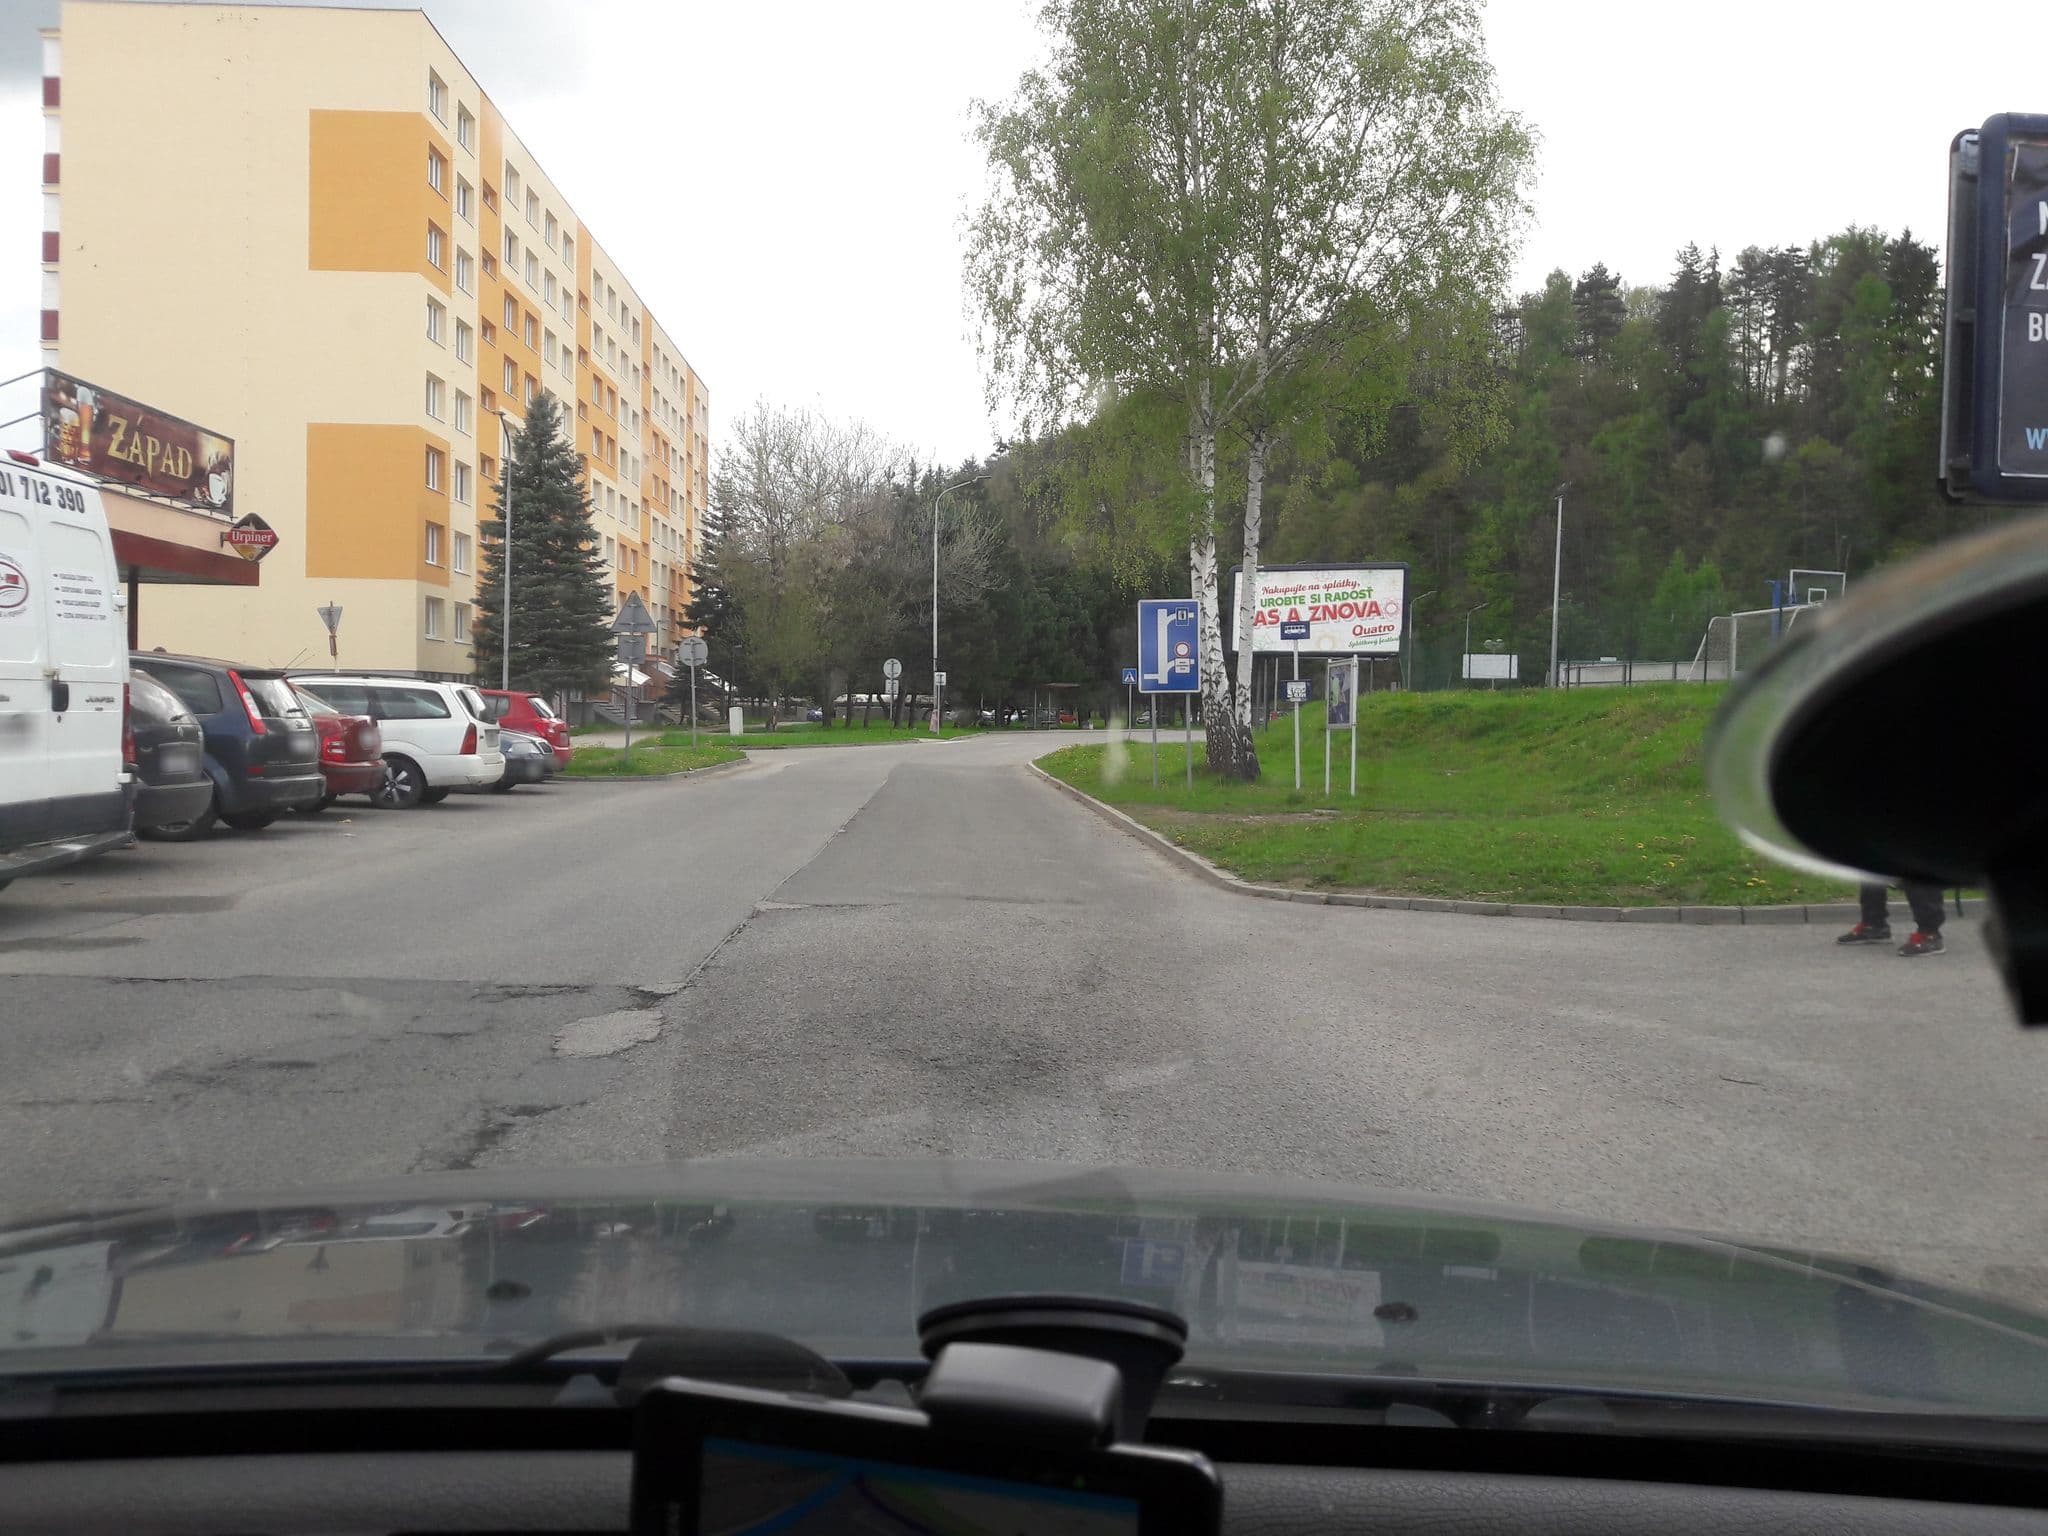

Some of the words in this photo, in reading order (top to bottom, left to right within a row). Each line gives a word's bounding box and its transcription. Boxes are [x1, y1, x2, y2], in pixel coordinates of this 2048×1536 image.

[107, 414, 193, 480] ZÁPAD
[19, 475, 51, 505] 712
[55, 485, 85, 513] 390
[232, 531, 273, 544] Urpiner
[1260, 595, 1305, 607] UROBTE
[1310, 593, 1321, 603] SI
[1325, 586, 1373, 602] RADOSŤ
[1261, 584, 1307, 595] Nakupujte
[1322, 578, 1361, 592] splátky,
[1253, 608, 1281, 626] AS
[1287, 607, 1300, 622] A
[1308, 601, 1381, 622] ZNOVA
[1352, 623, 1395, 636] Quatro
